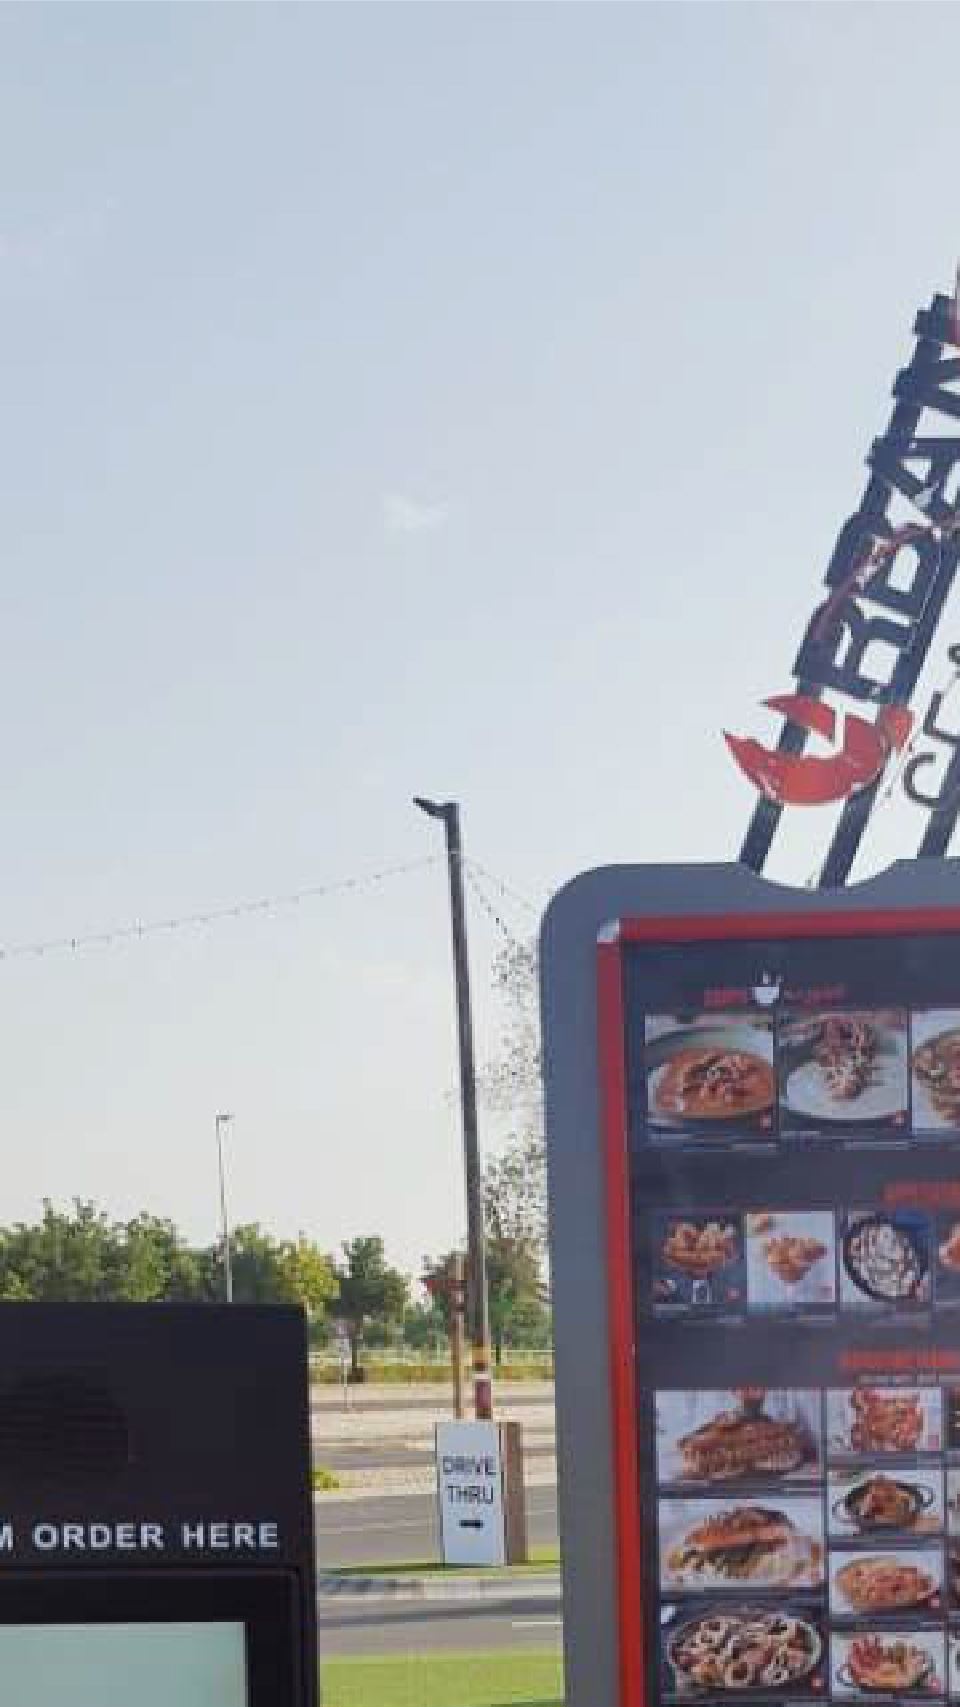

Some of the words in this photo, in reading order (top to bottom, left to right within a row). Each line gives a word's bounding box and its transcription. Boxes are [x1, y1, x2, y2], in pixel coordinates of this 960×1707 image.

[442, 1455, 497, 1476] DRIVE
[447, 1485, 494, 1504] THRU
[32, 1522, 165, 1549] ORDER
[183, 1522, 278, 1549] HERE
